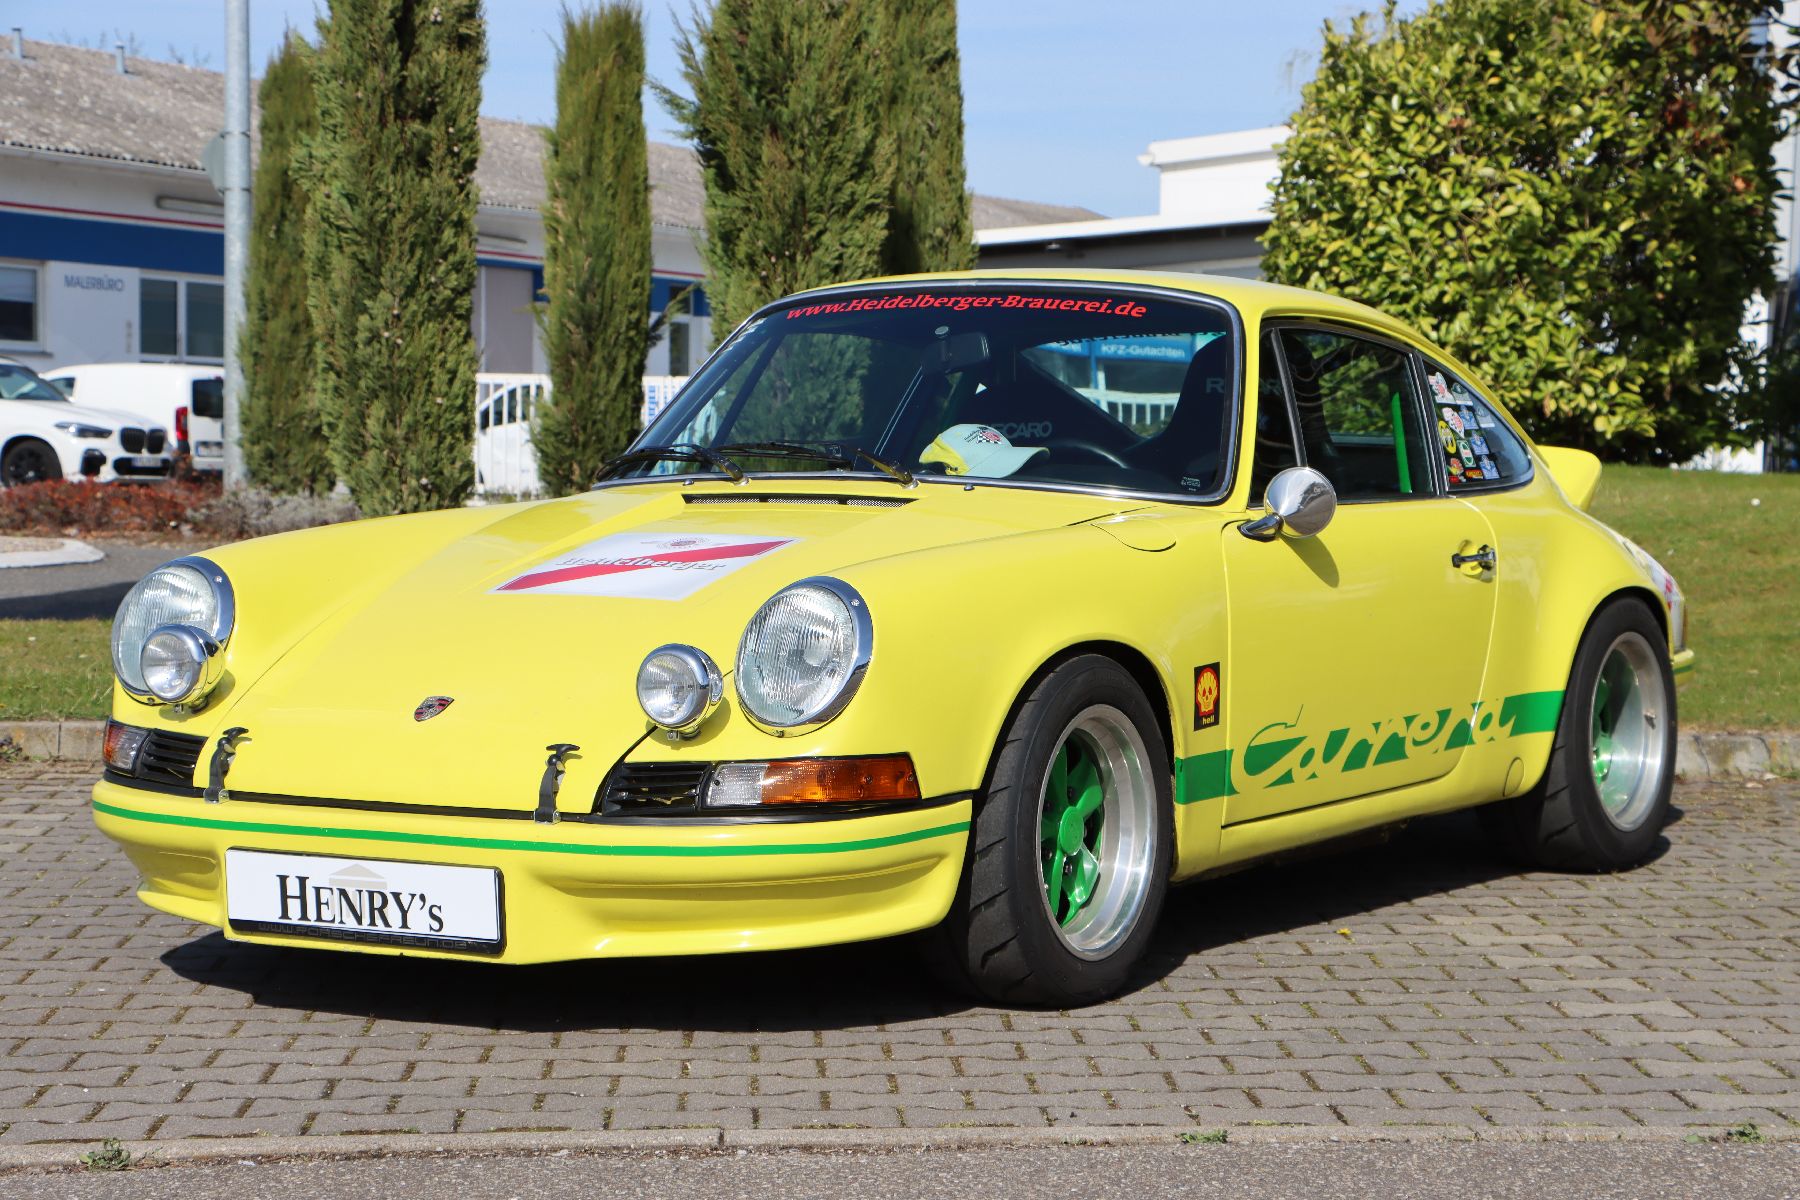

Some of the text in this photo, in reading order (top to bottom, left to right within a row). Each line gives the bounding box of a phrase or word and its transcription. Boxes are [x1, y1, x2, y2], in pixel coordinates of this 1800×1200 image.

[64, 274, 125, 292] MALERBÜRO
[787, 294, 1148, 319] www.Heidelberger-Brauerei.de
[1101, 343, 1186, 358] KFZ-Gutachten
[556, 556, 728, 572] Heidelberger
[1202, 715, 1215, 726] hell
[1231, 700, 1515, 794] Carrera
